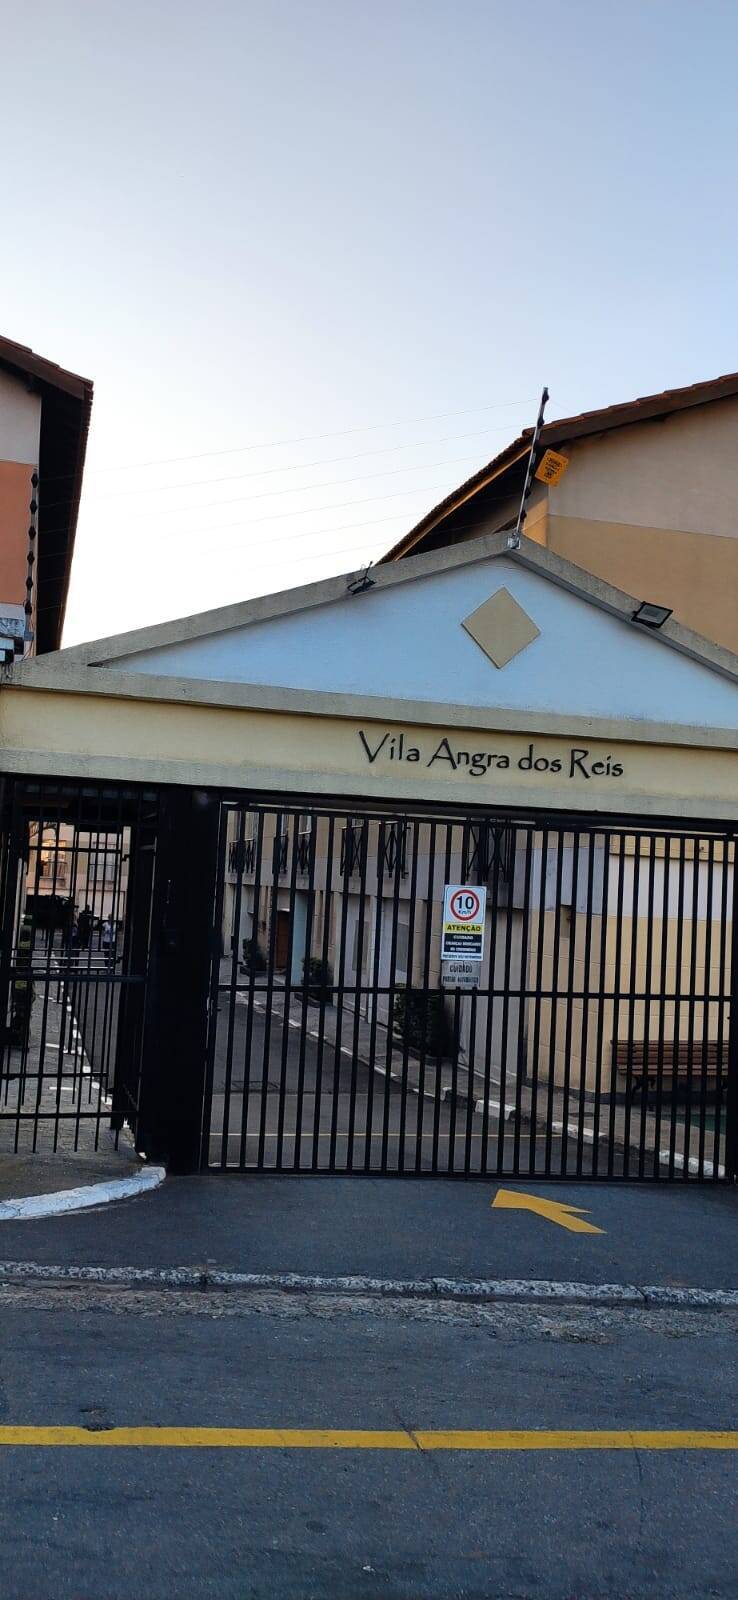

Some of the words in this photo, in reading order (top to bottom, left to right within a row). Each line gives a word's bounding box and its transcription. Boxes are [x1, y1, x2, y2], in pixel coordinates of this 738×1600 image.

[359, 730, 420, 763] Vila
[426, 737, 510, 776] Angra
[518, 743, 562, 772] dos
[569, 748, 624, 779] Reis
[457, 895, 474, 909] 10
[447, 924, 481, 932] ATENÇÃO
[449, 964, 473, 973] CUIDADO
